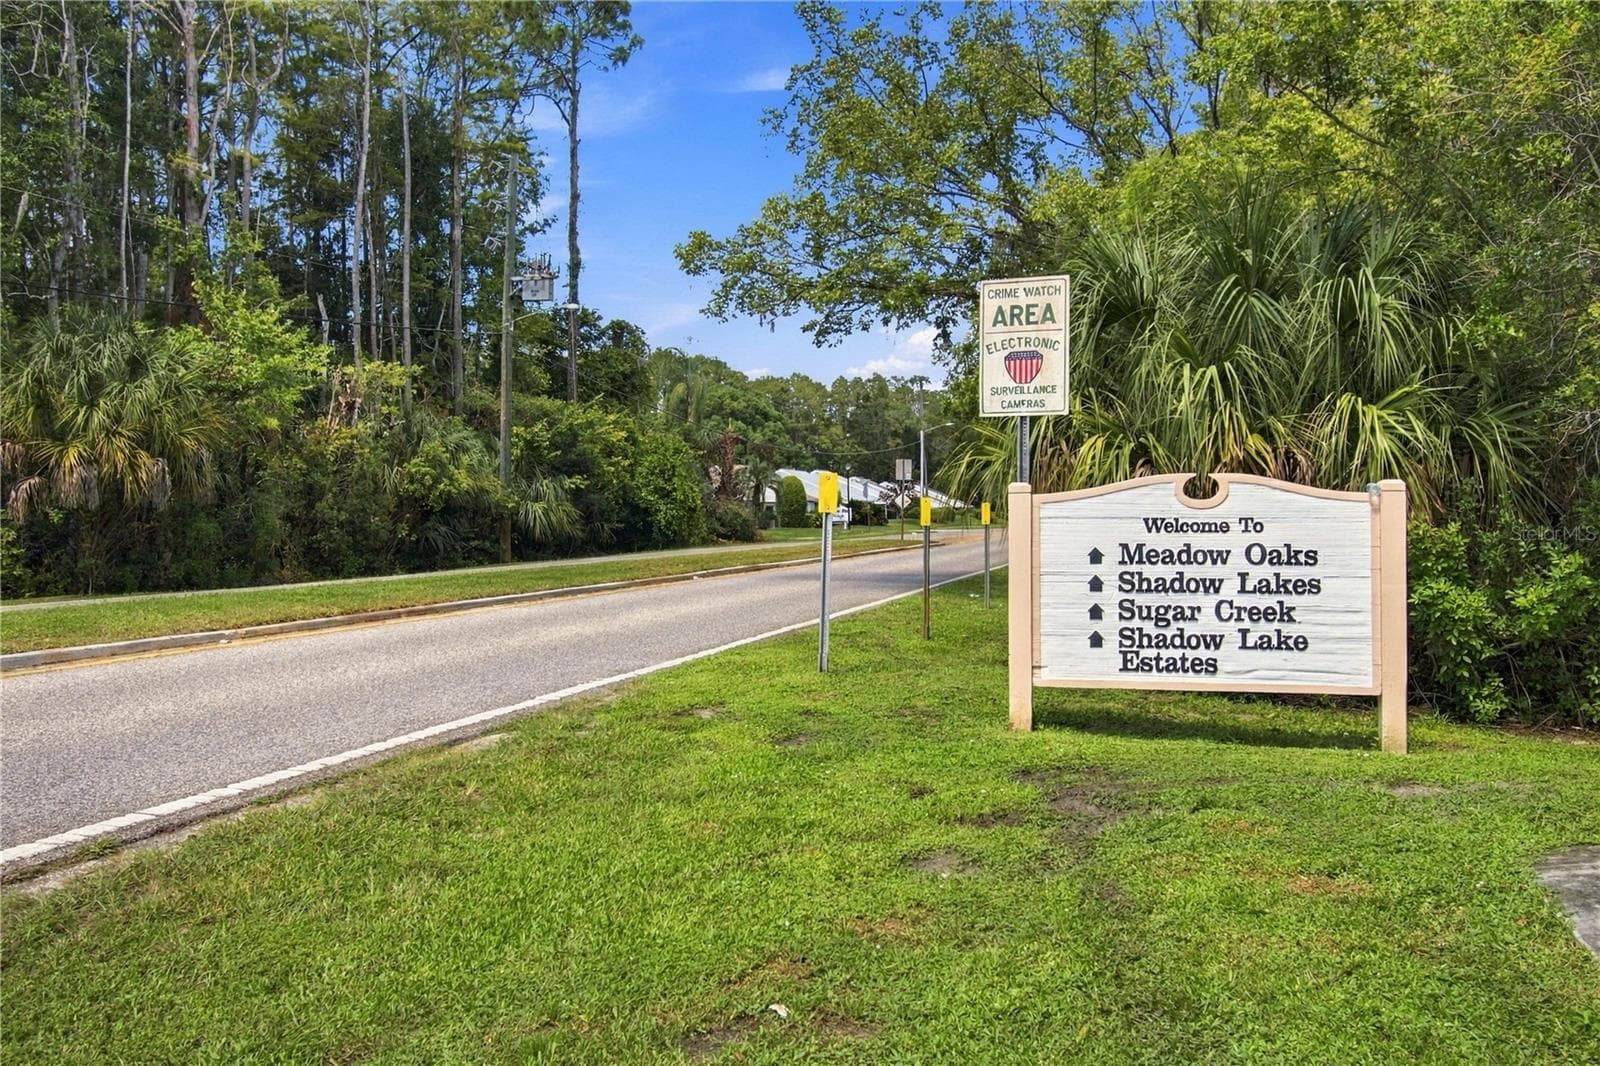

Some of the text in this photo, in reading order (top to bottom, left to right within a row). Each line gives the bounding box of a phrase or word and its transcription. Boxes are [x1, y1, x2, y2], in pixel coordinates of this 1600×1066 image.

[987, 285, 1061, 300] CRIME WATCH
[992, 303, 1057, 327] AREA
[985, 337, 1061, 355] ELECTRONIC
[990, 384, 1057, 396] SURVEILLANCE
[1143, 517, 1264, 534] Welcome To
[1118, 543, 1319, 567] Meadow Oaks
[1117, 571, 1322, 596] Shadow Lakes
[1117, 599, 1297, 628] Sugar Creek
[1117, 627, 1309, 652] Shadow Lake
[1118, 650, 1218, 674] Estates
